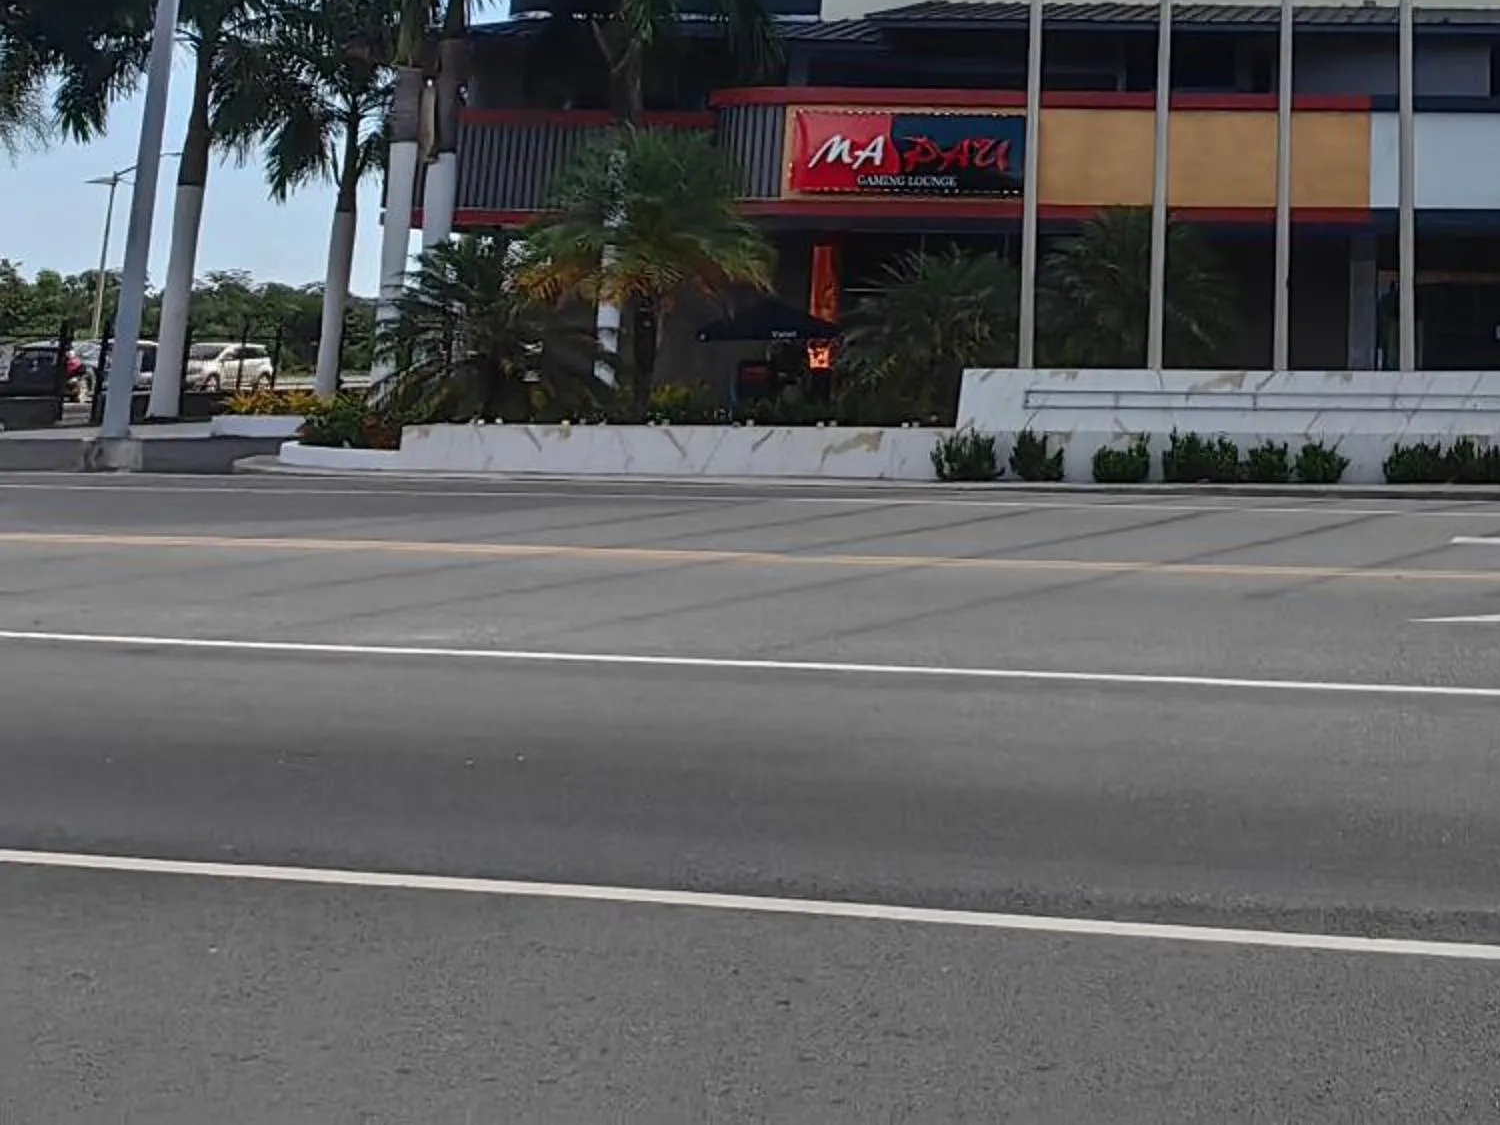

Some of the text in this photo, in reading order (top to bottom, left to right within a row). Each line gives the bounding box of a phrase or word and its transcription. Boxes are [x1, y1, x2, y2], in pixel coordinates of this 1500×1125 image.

[808, 134, 885, 170] MA
[857, 174, 957, 187] GAMING LOUNGE
